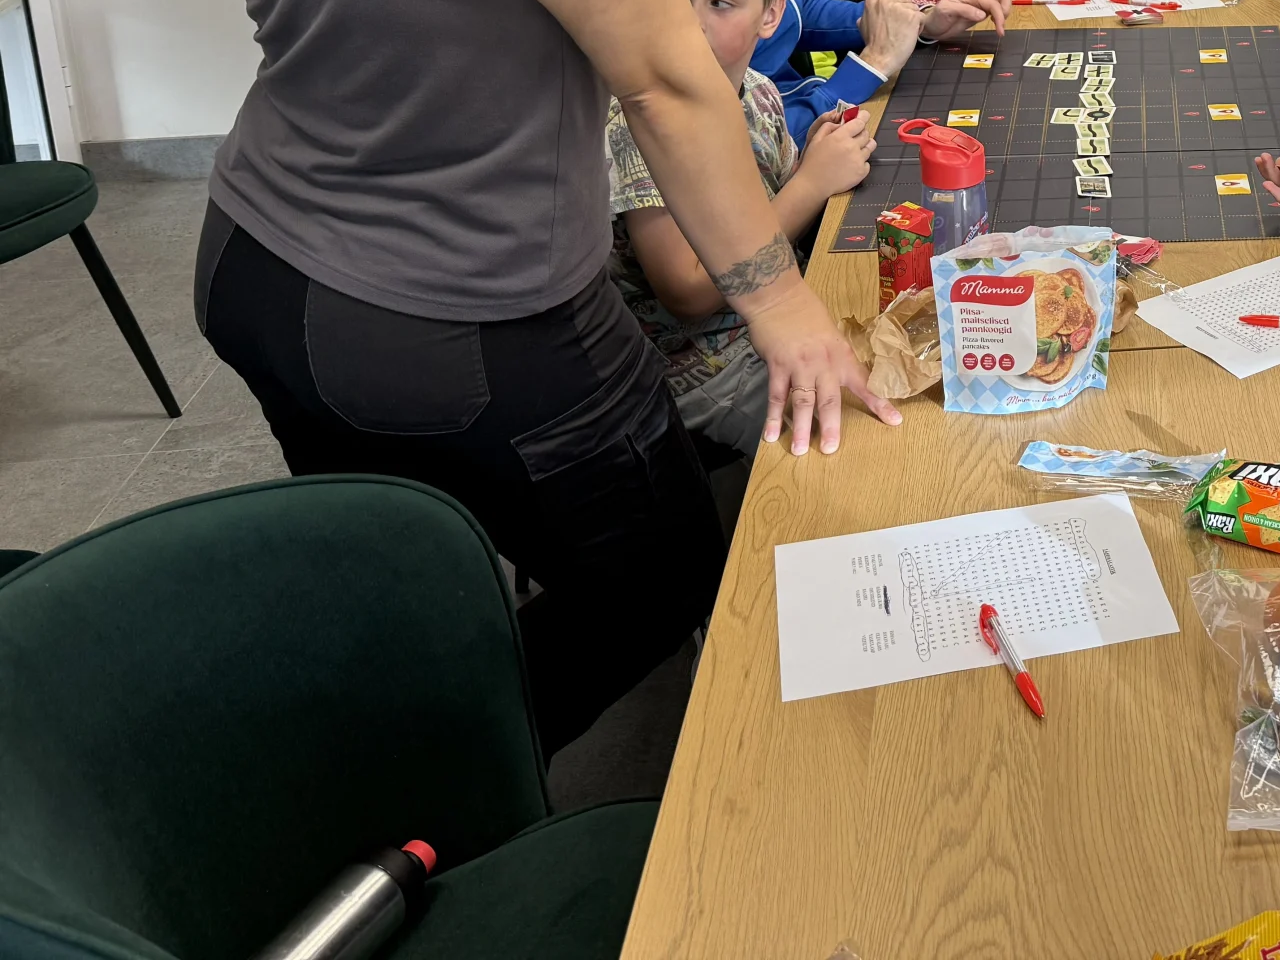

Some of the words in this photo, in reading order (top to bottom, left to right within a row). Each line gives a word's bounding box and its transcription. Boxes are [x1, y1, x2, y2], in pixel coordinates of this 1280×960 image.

[960, 280, 1025, 296] Mamma
[961, 317, 1009, 325] maitselised
[961, 326, 1012, 335] pannkoogid
[1244, 513, 1260, 524] ONION
[1264, 519, 1280, 529] CREAM
